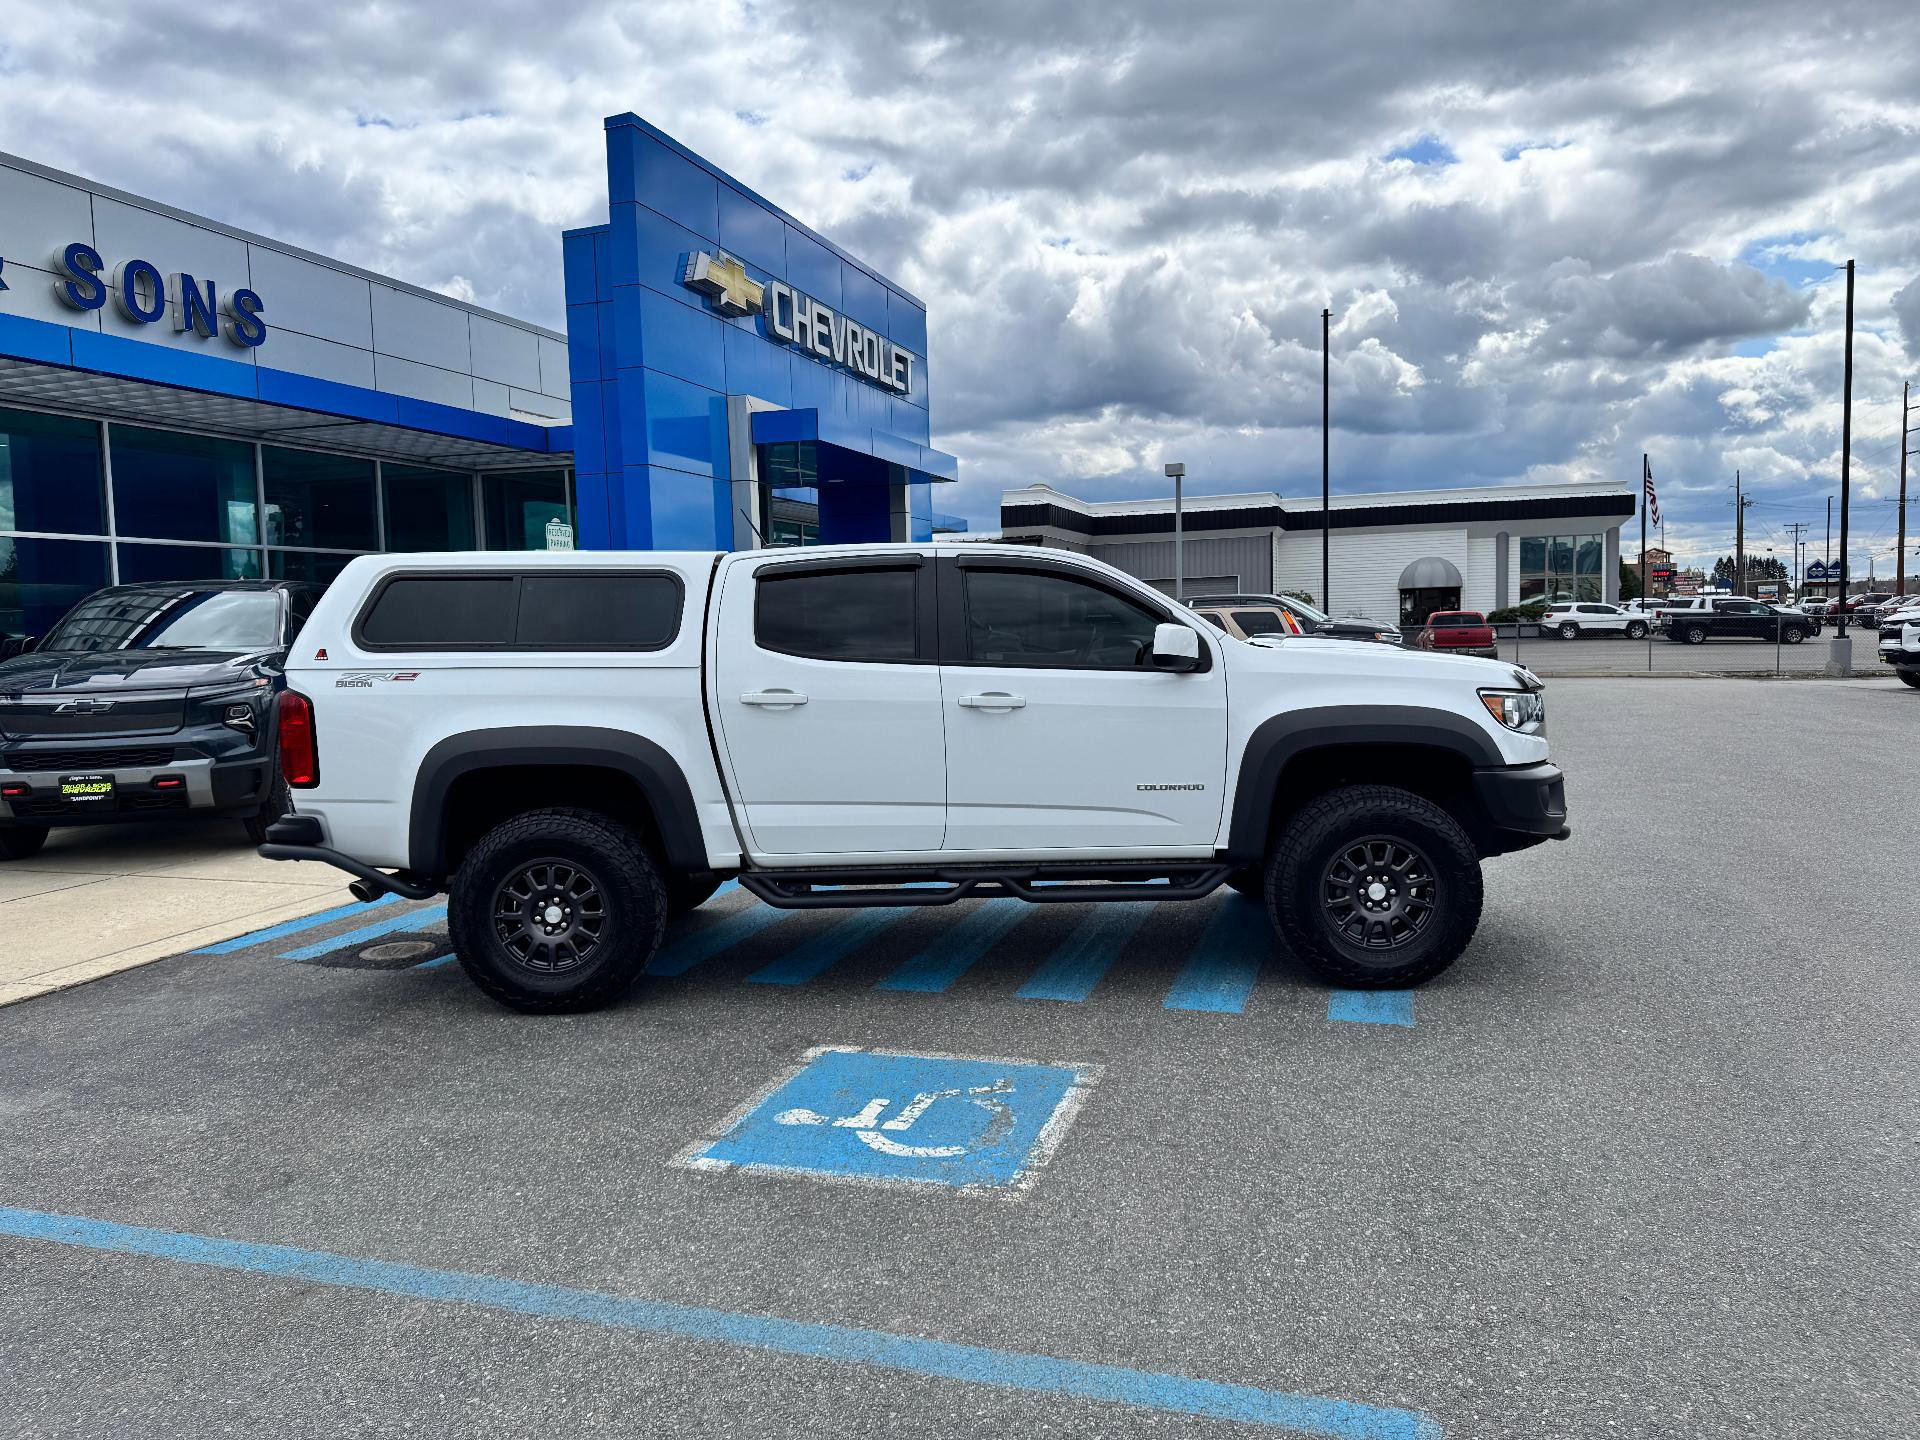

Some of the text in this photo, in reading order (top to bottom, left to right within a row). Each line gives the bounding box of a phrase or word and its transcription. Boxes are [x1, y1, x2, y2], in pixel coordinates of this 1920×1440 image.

[53, 242, 267, 347] SONS
[765, 280, 915, 395] CHEVROLET
[1136, 783, 1205, 791] COLORADO
